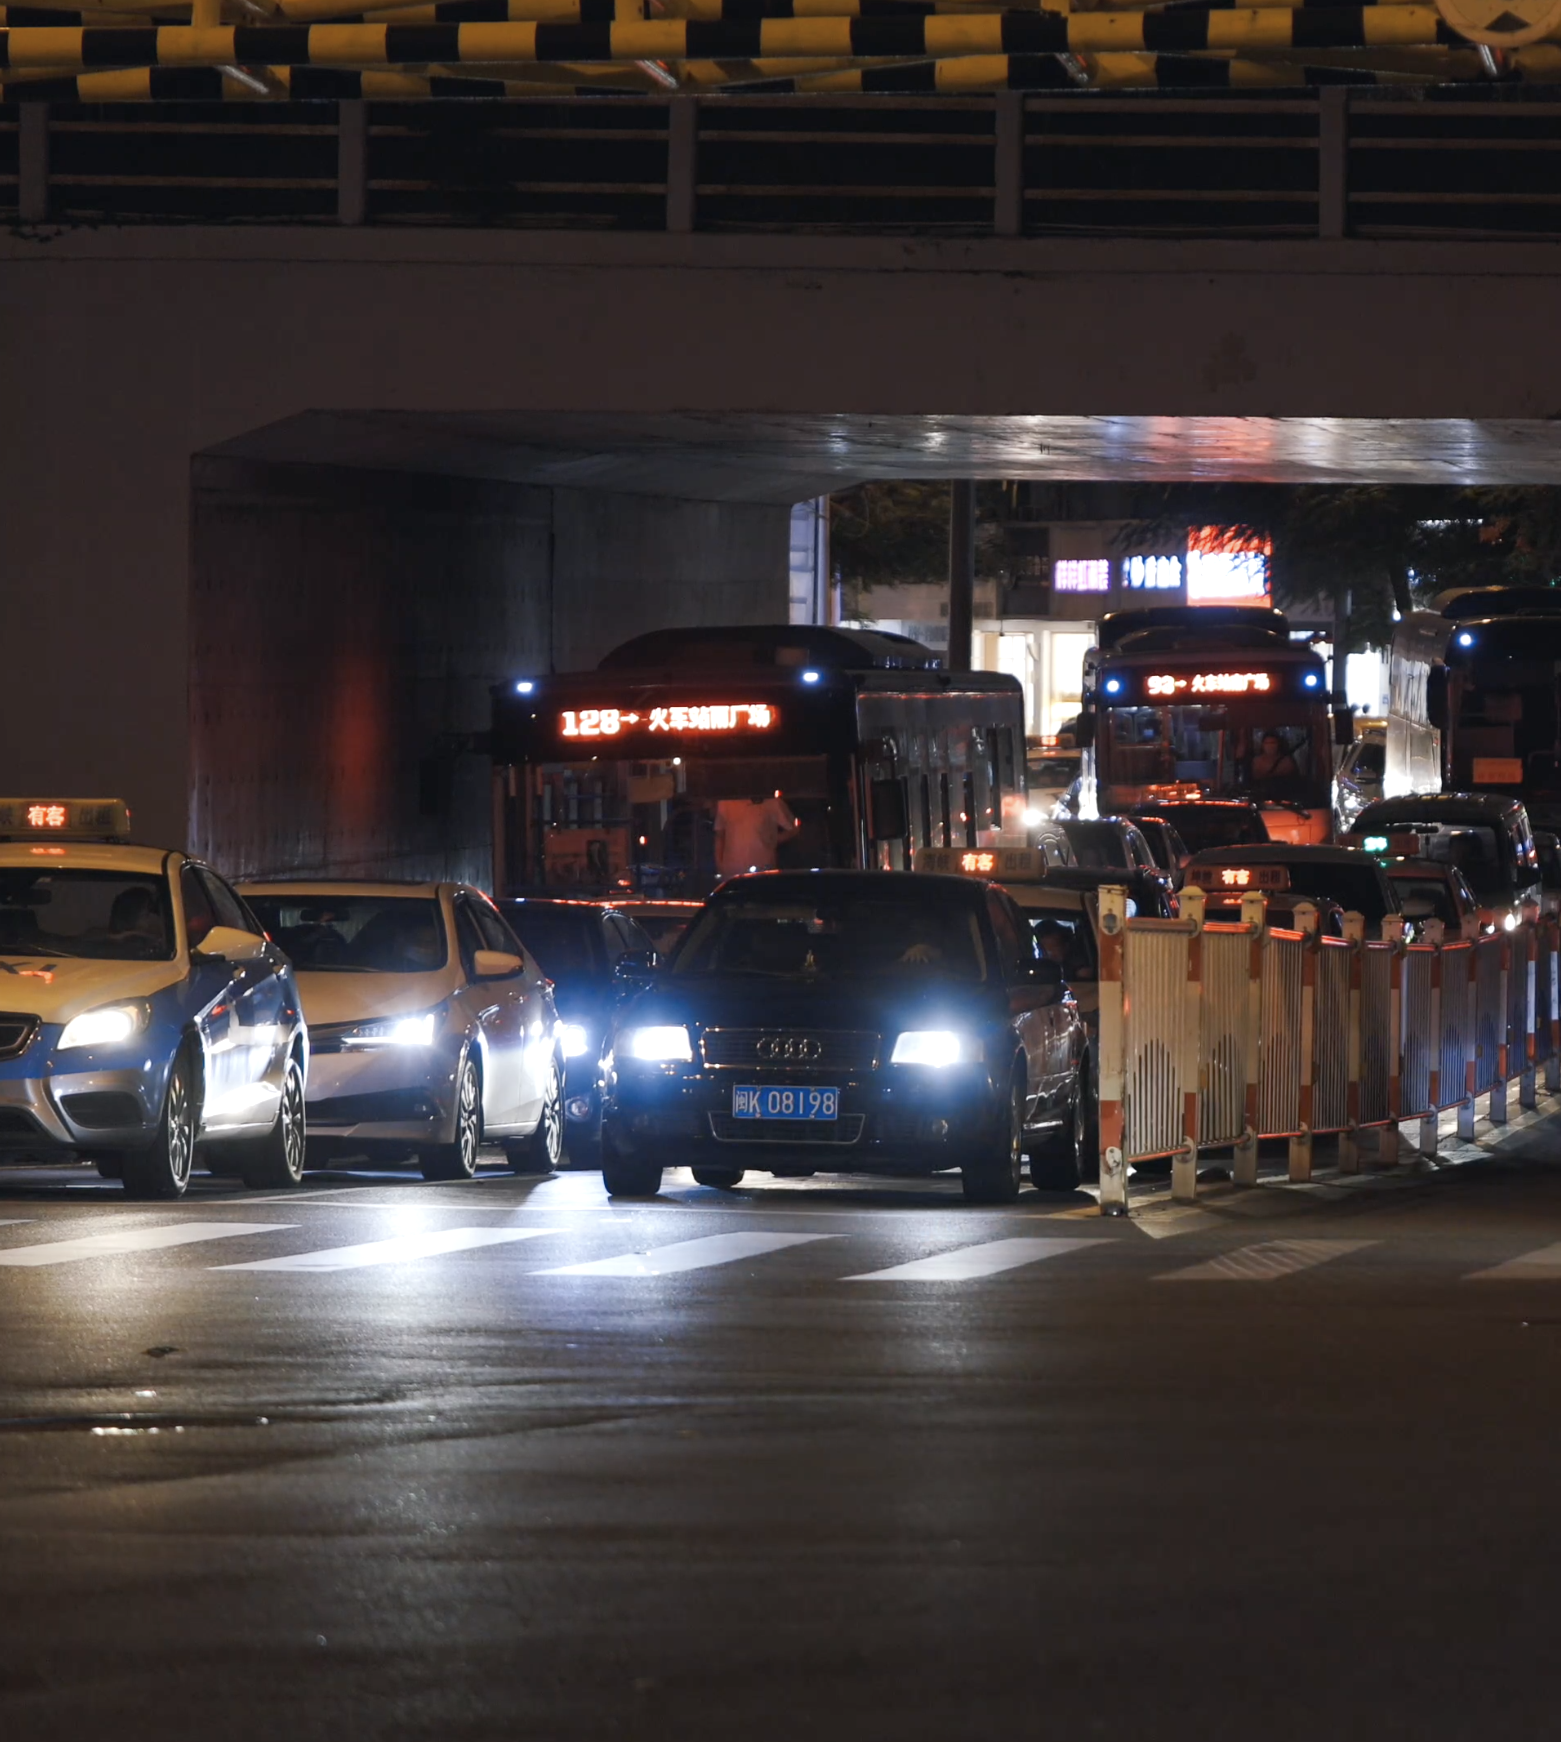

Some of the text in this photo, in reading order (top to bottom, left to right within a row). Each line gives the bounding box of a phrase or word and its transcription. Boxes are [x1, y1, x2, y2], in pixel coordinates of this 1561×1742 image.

[561, 708, 621, 736] 128
[27, 805, 66, 827] 有客
[961, 852, 994, 872] 有客
[1221, 868, 1251, 885] 有客
